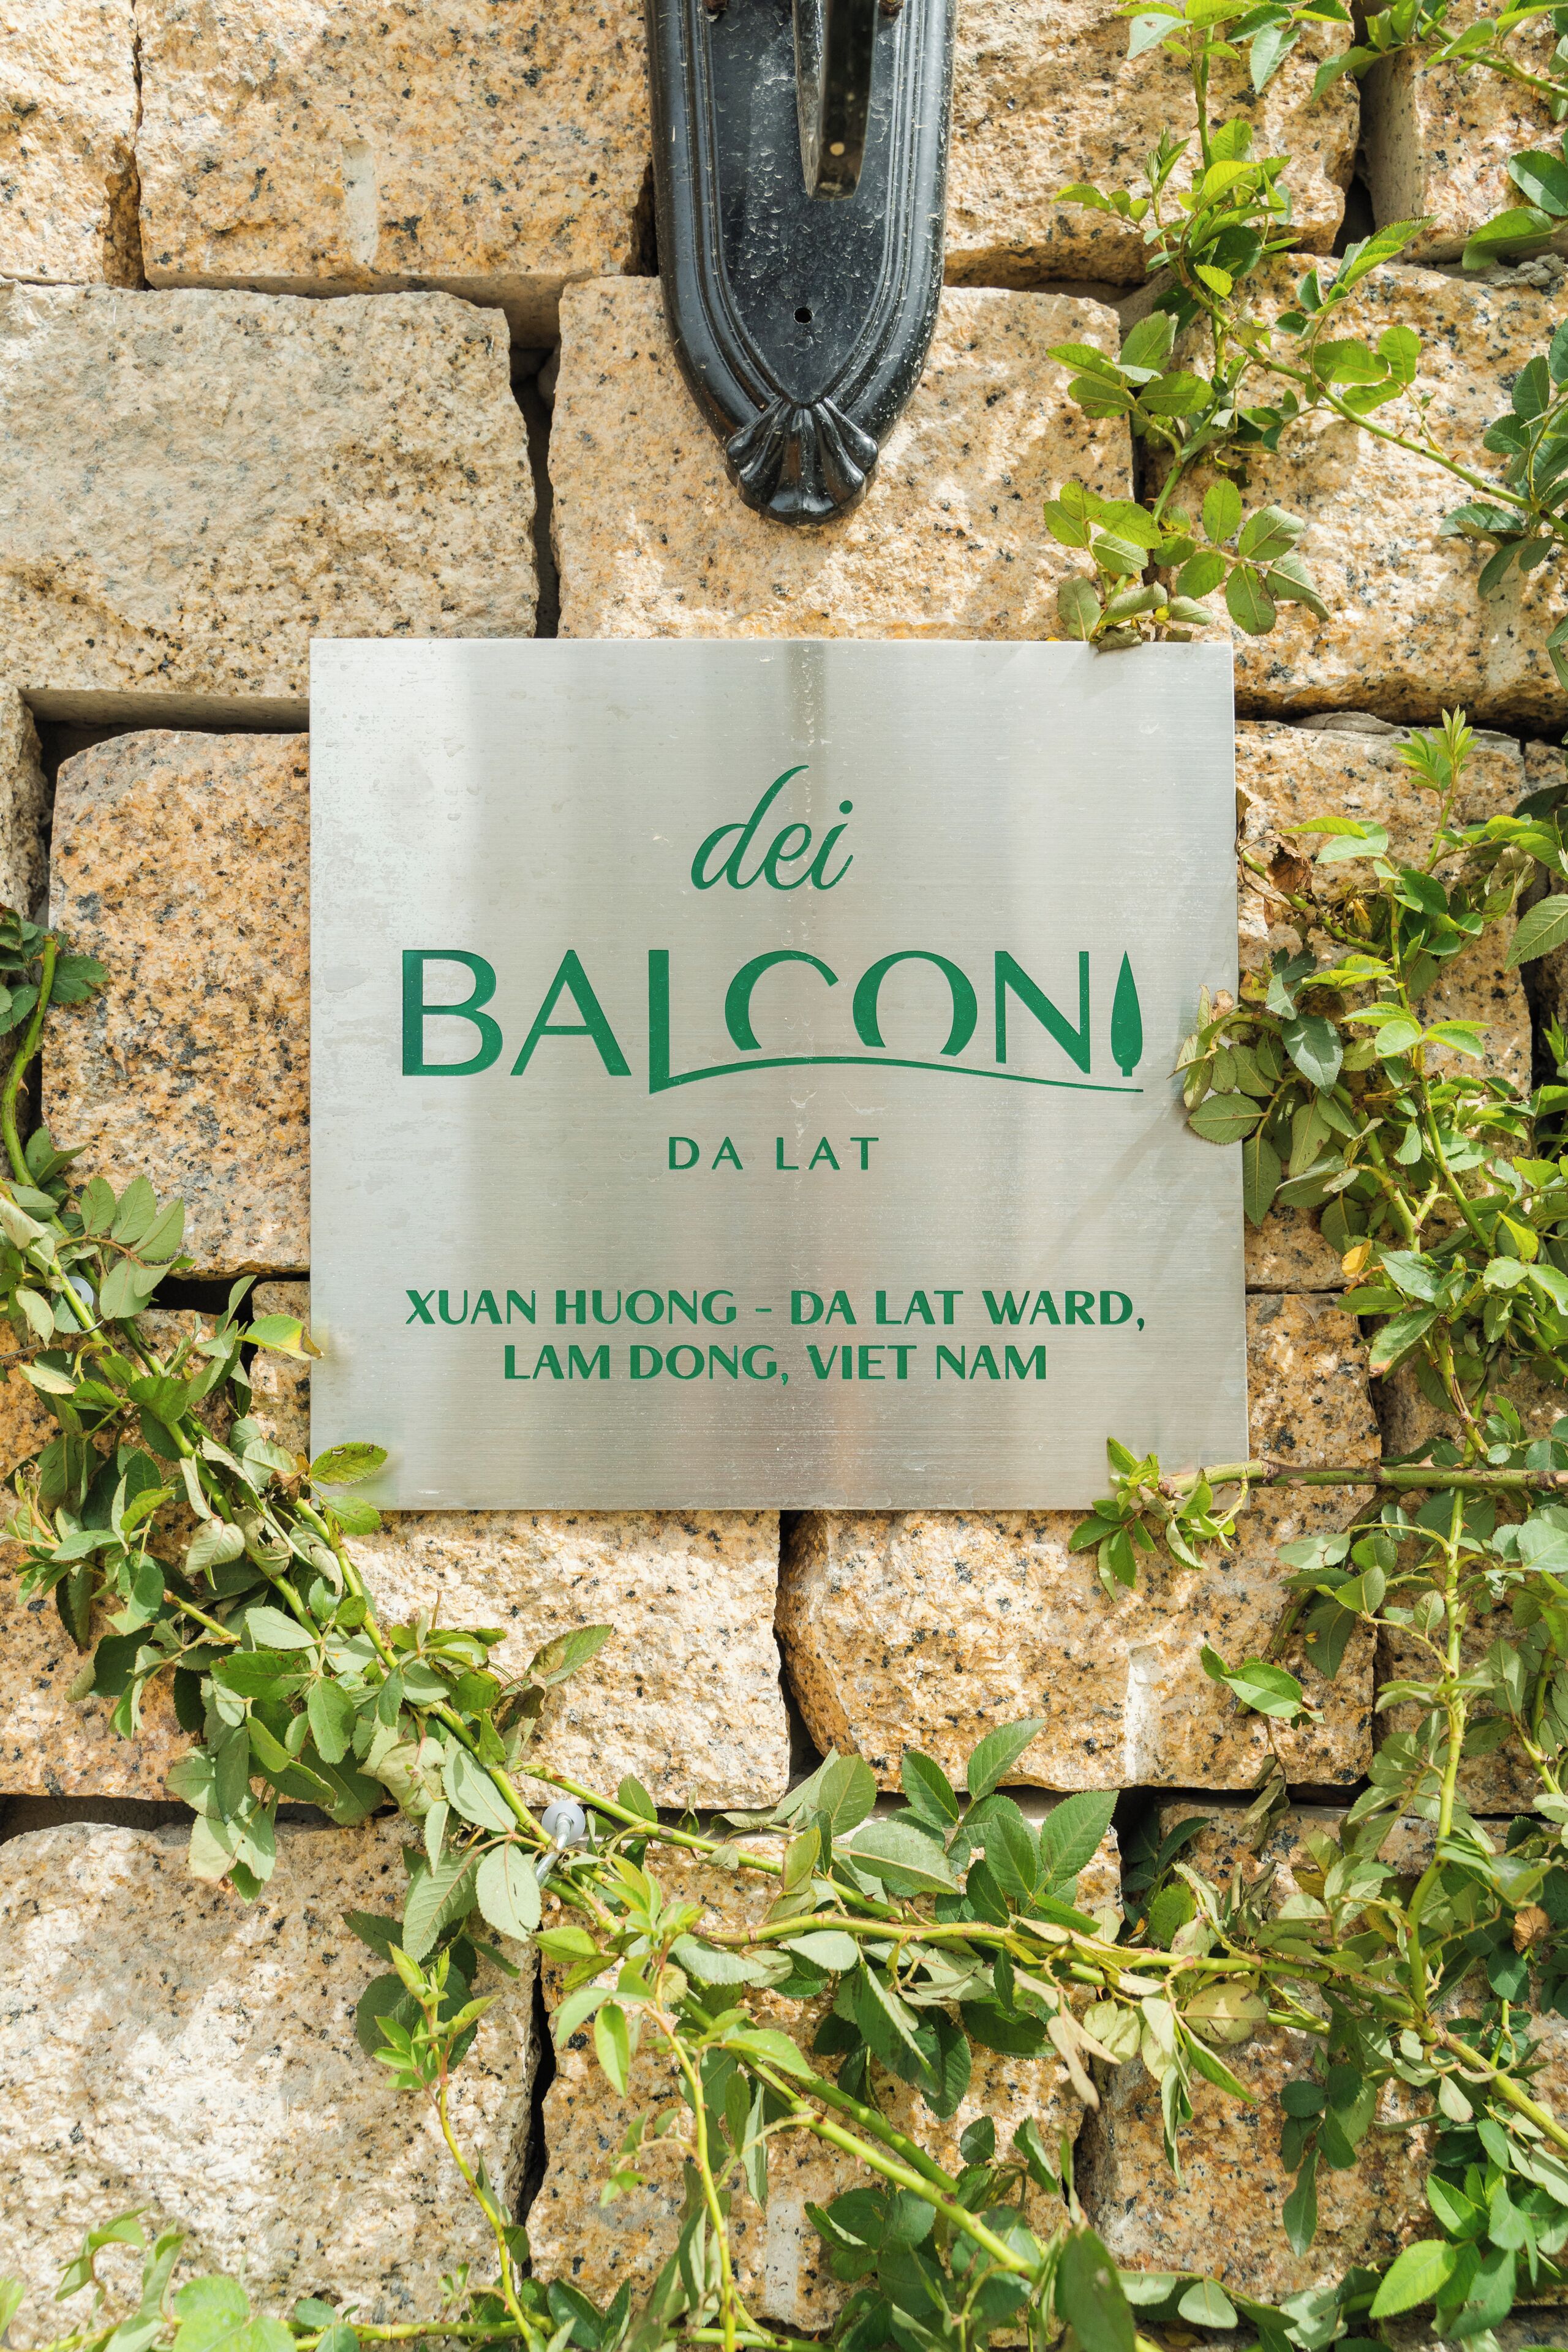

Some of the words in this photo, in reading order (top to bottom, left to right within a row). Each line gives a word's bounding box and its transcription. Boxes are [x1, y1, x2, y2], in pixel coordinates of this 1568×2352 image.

[690, 764, 853, 891] dei
[401, 949, 1144, 1095] BALCONI
[668, 1136, 743, 1170] DA
[775, 1136, 879, 1170] LAT
[405, 1289, 537, 1325] XUAN
[555, 1289, 737, 1325] HUONG
[790, 1289, 858, 1325] DA
[875, 1289, 963, 1325] LAT
[981, 1290, 1145, 1332] WARD,
[503, 1344, 611, 1380] LAM
[629, 1344, 789, 1386] DONG,
[805, 1344, 918, 1380] VIET
[935, 1344, 1047, 1380] NAM
